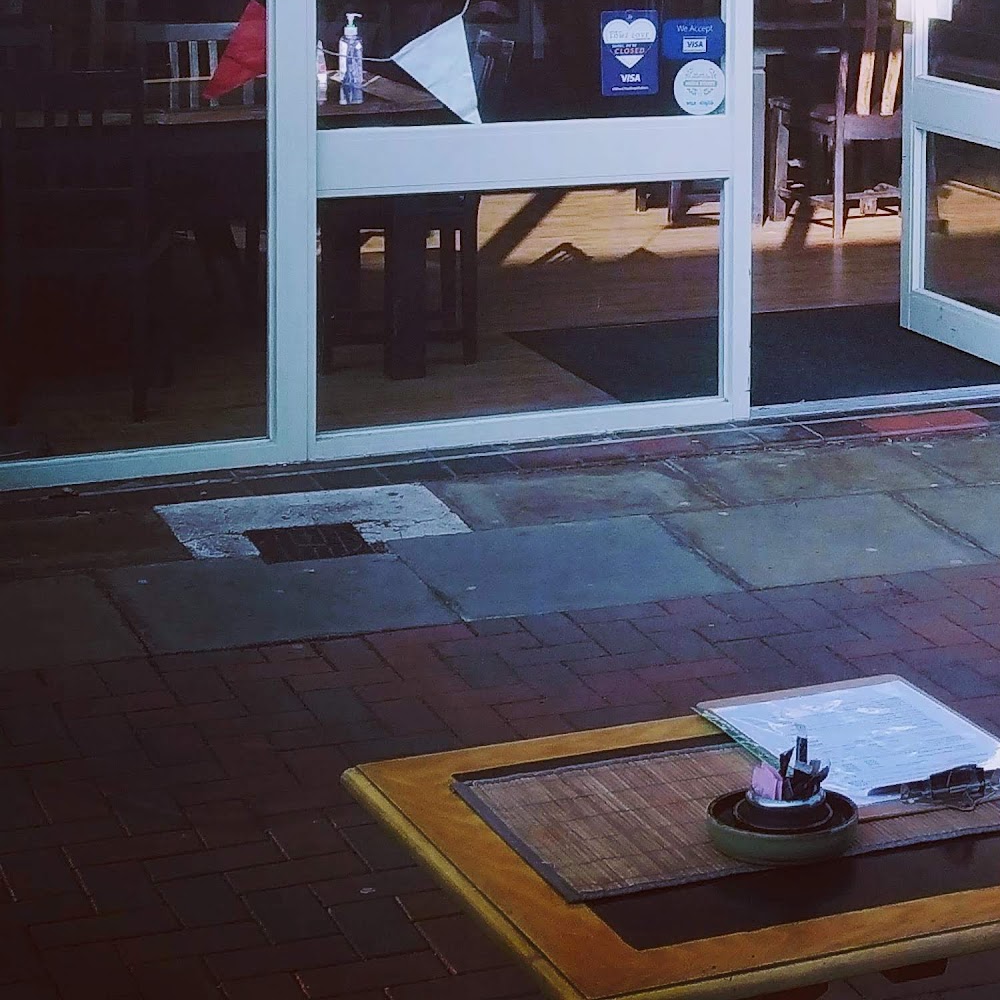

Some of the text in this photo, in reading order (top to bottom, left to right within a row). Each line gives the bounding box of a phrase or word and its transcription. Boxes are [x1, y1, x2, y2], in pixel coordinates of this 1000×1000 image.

[676, 24, 714, 34] We Accept
[686, 41, 704, 49] VISA
[614, 47, 646, 55] CLOSED
[620, 73, 642, 83] VISA
